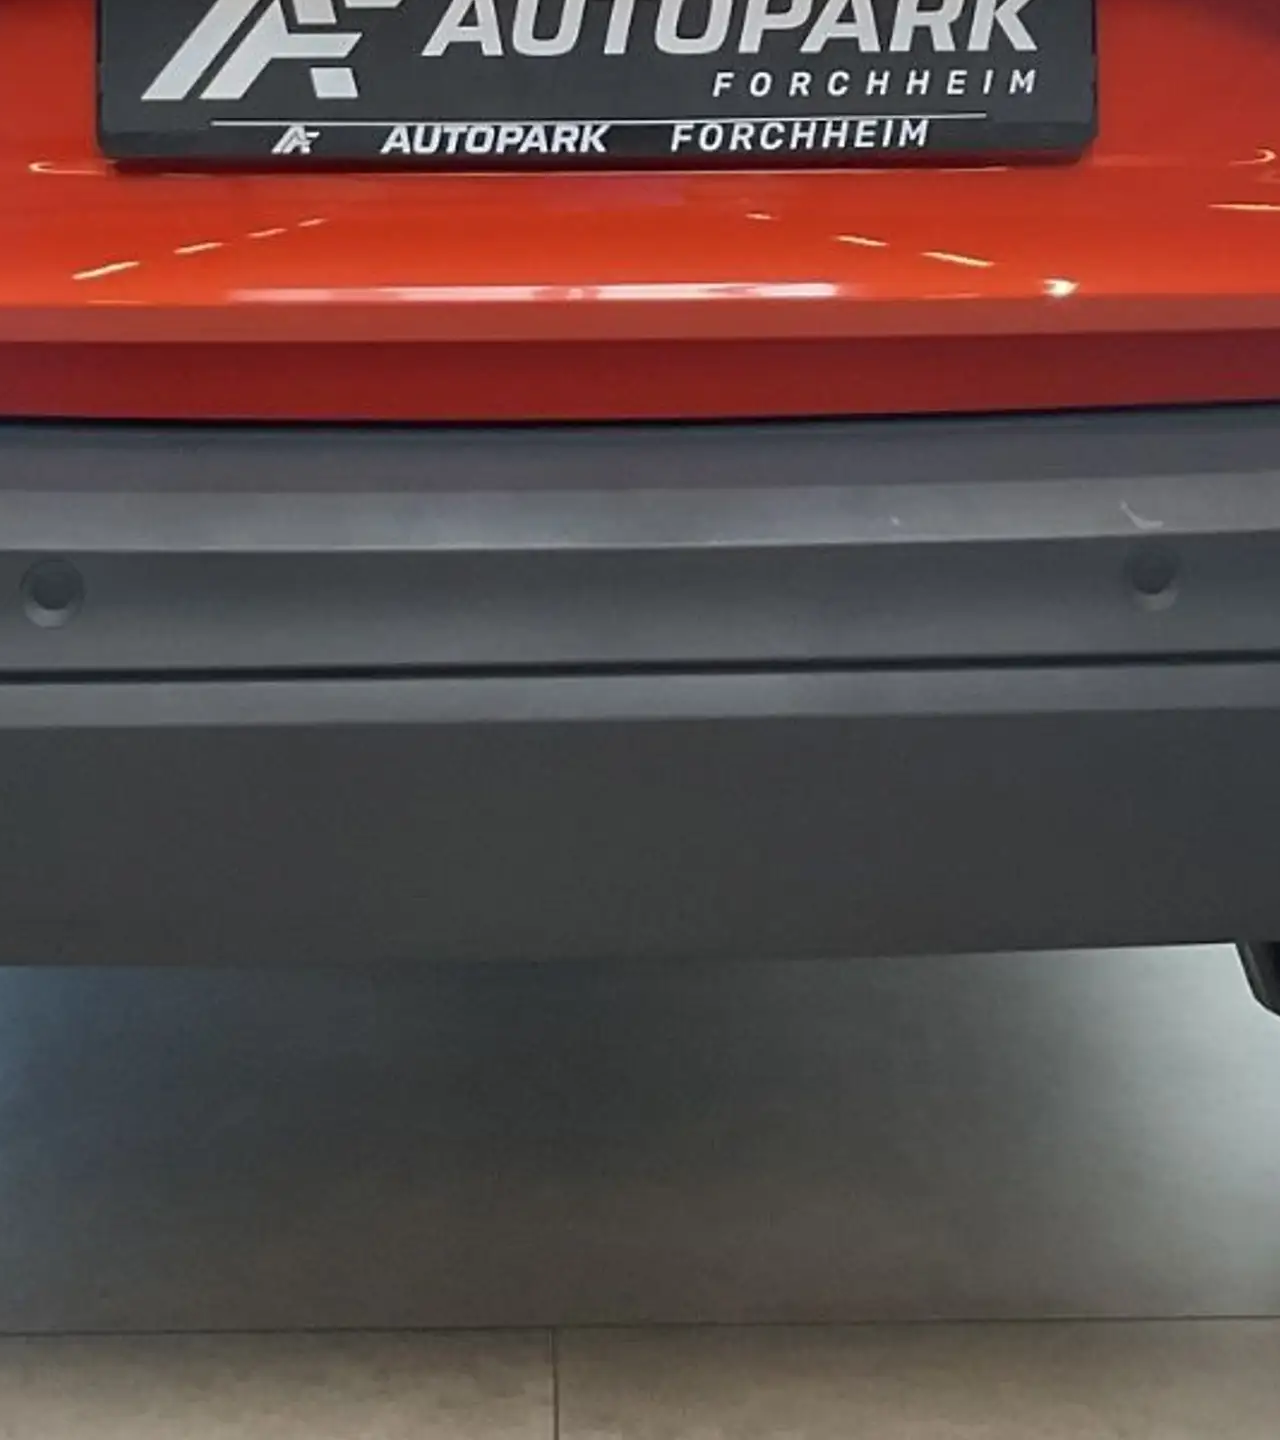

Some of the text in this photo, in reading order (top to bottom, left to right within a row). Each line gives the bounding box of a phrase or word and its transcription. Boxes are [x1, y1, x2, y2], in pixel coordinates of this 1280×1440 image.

[712, 69, 1036, 98] FORCHHEIM
[380, 123, 613, 156] AUTOPARK
[671, 119, 931, 153] FORCHHEIM
